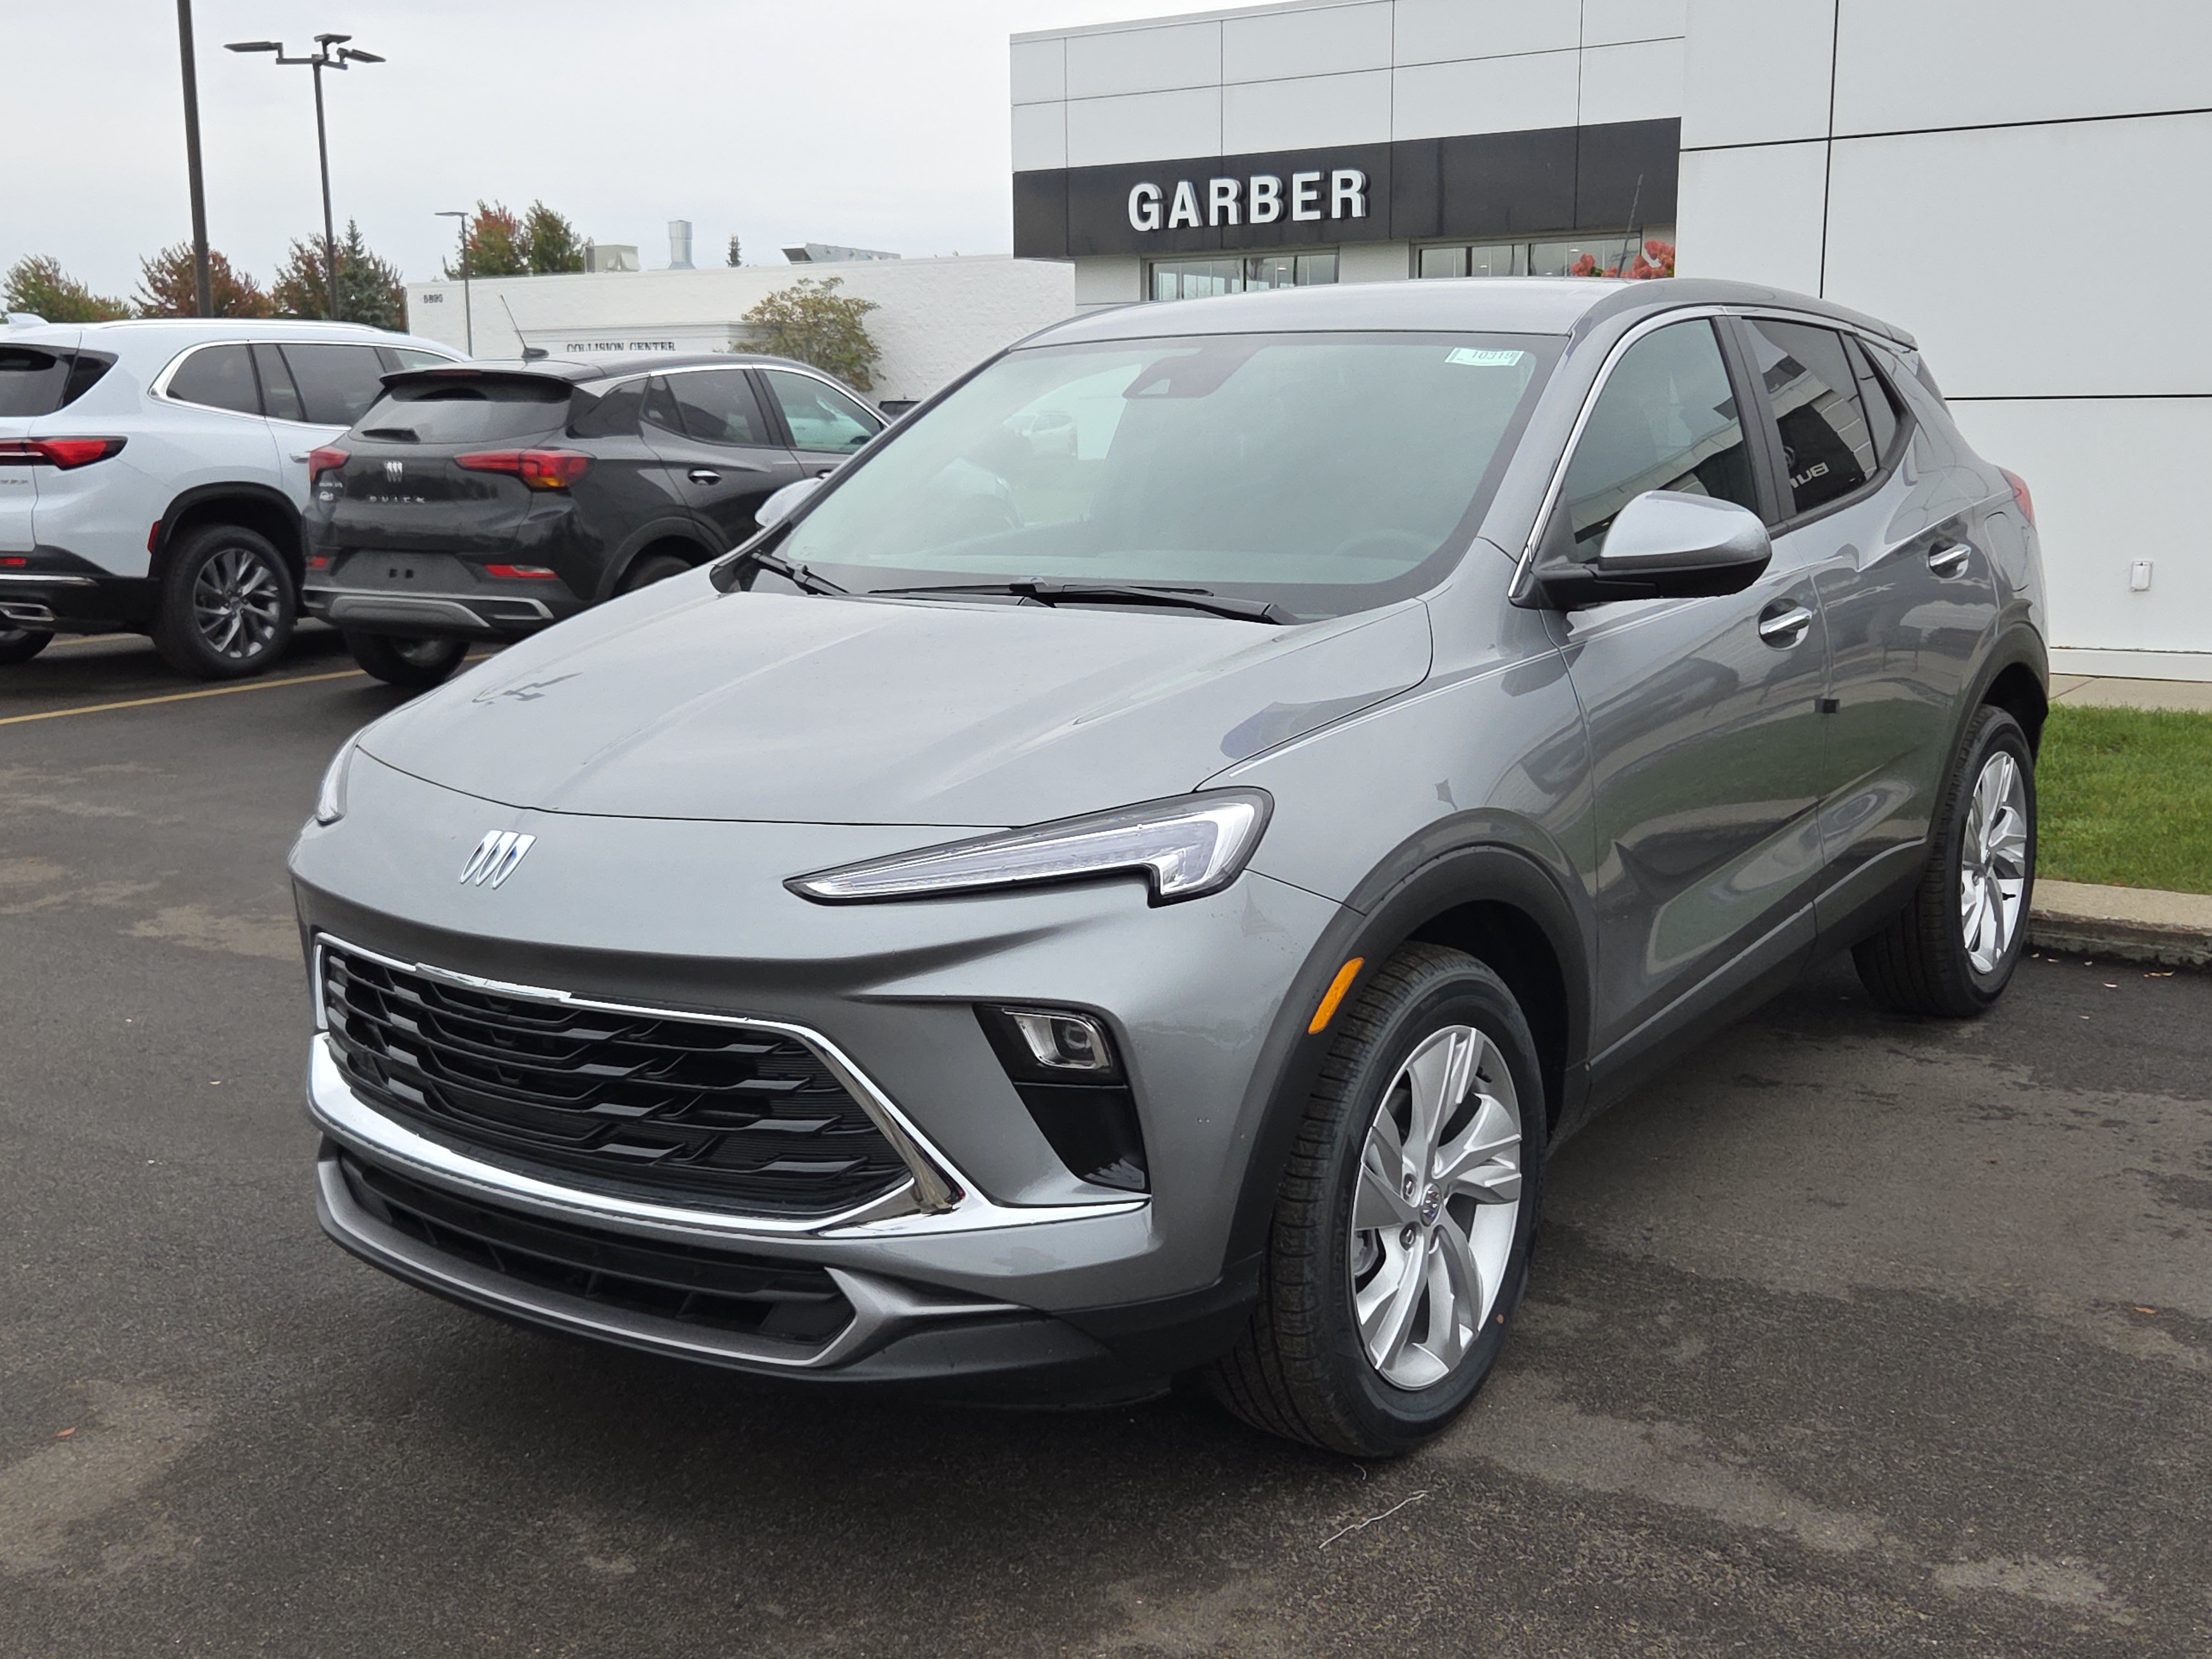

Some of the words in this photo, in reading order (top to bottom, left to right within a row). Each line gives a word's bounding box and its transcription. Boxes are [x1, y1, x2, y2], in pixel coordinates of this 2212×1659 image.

[1128, 168, 1367, 232] GARBER
[567, 343, 624, 352] COLLISION
[629, 342, 676, 351] CENTER
[1472, 351, 1514, 359] 10319
